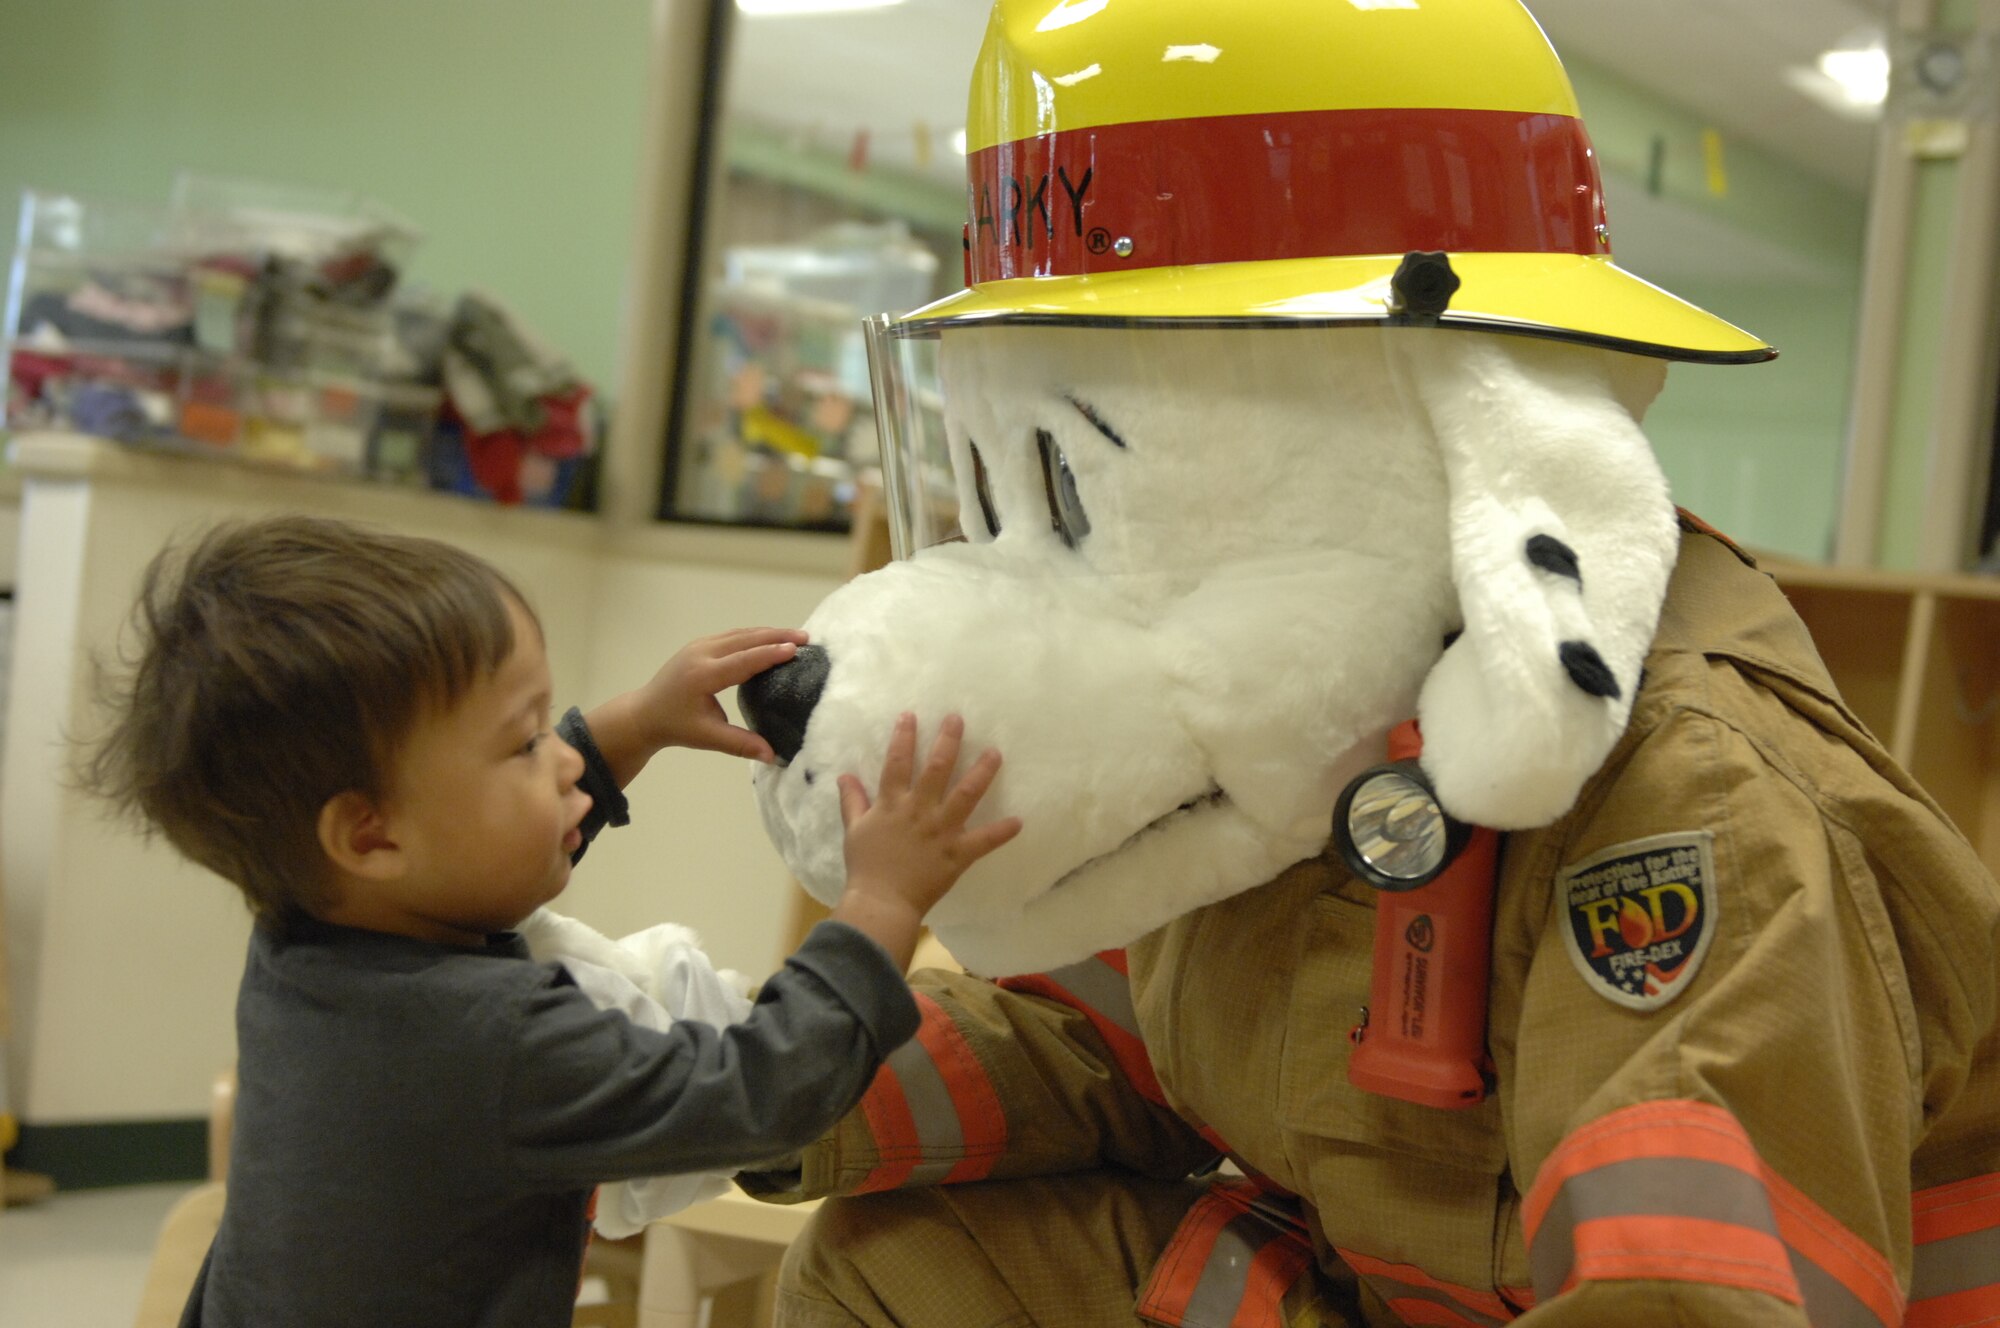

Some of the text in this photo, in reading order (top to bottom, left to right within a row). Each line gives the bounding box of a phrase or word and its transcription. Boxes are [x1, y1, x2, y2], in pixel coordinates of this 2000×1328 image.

[1568, 848, 1699, 890] Protection for the
[1603, 881, 1618, 895] of
[1622, 875, 1650, 891] the
[1608, 939, 1684, 972] FIRE-DEX
